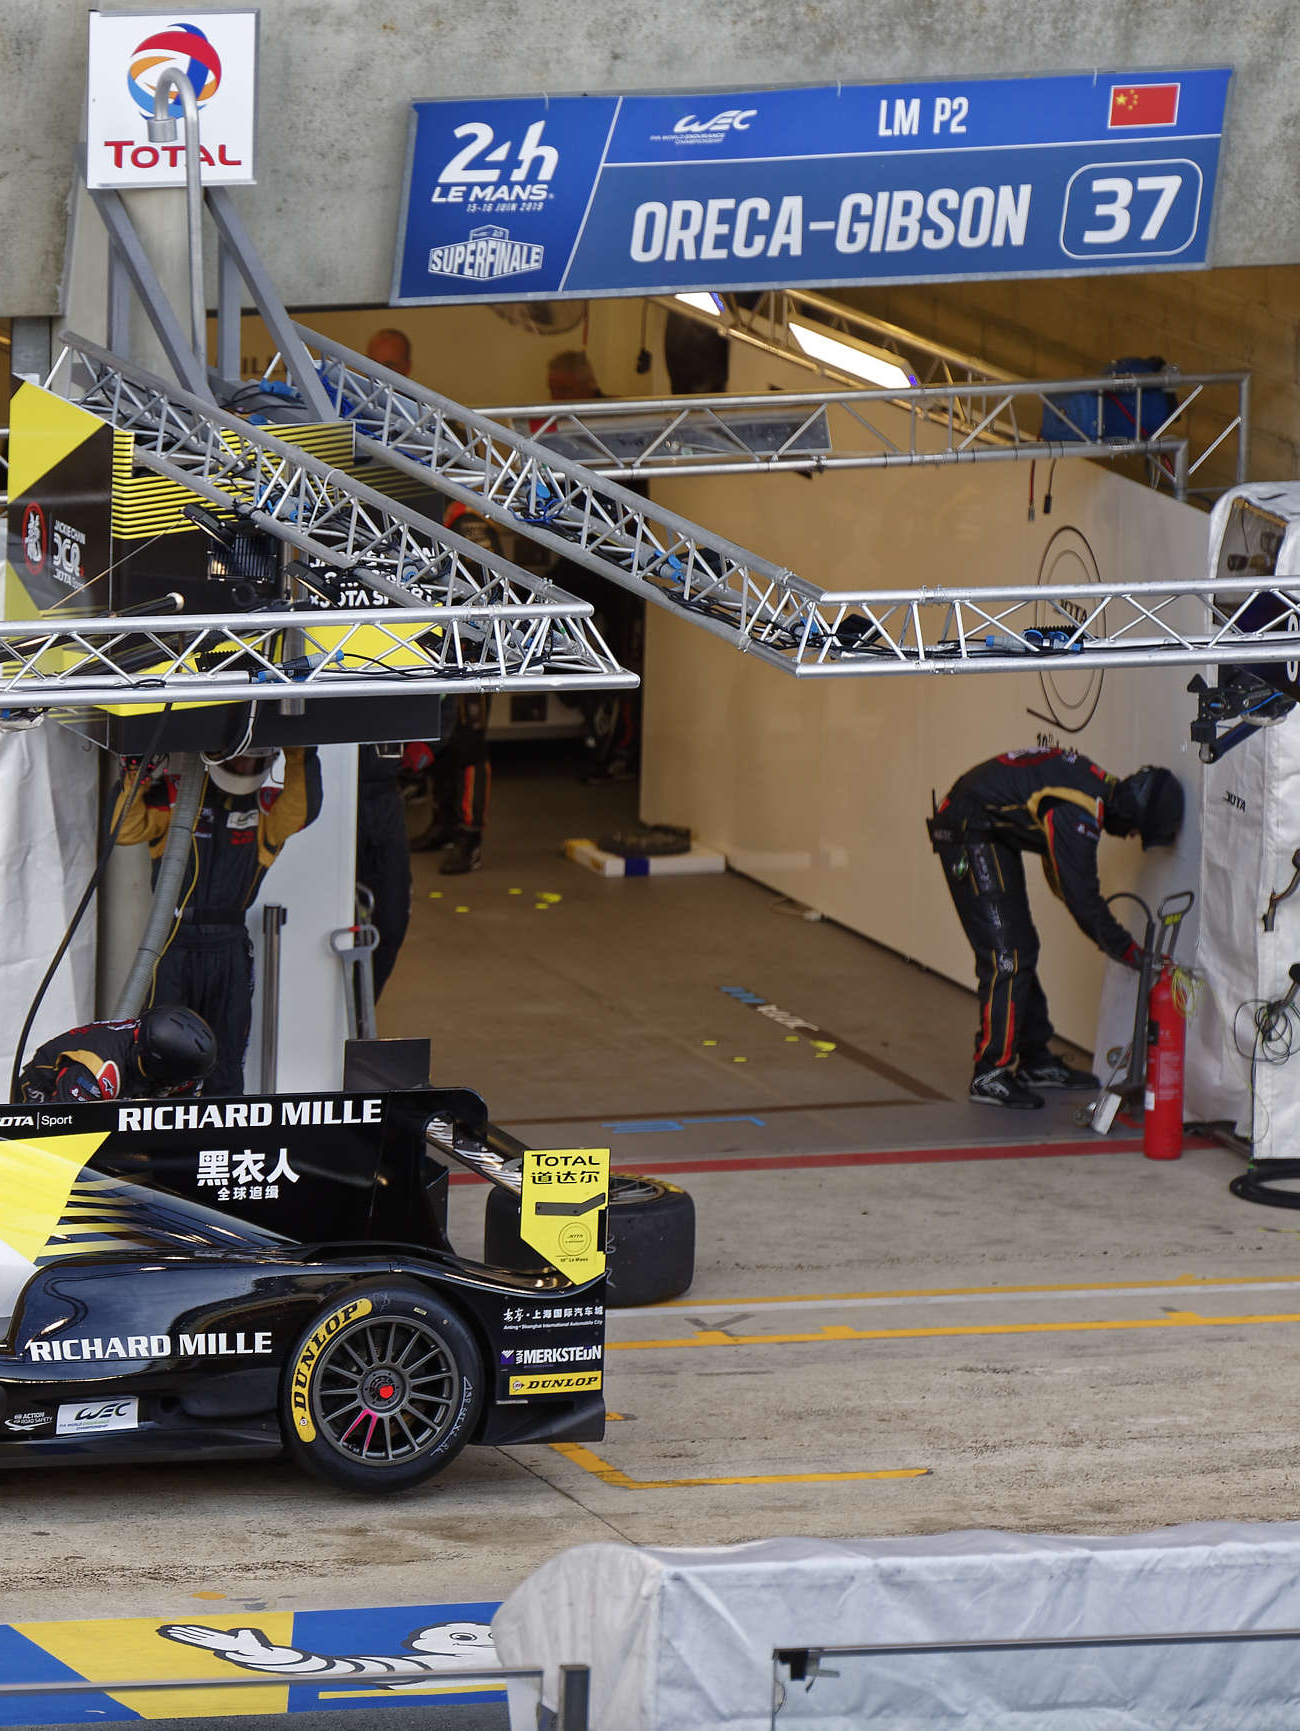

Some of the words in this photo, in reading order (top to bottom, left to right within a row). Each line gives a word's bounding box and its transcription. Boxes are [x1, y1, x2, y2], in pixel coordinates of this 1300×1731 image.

[673, 109, 758, 133] WEC
[878, 98, 921, 136] LM
[933, 96, 969, 134] P2
[437, 120, 559, 183] 24h
[431, 186, 467, 203] LE
[1083, 175, 1183, 243] 37
[630, 182, 1032, 263] ORECA-GIBSON
[431, 239, 542, 279] SUPERFINALE
[41, 1115, 73, 1127] Sport
[118, 1104, 272, 1132] RICHARD
[281, 1099, 382, 1126] MILLE
[197, 1148, 300, 1186] 黑衣人
[531, 1154, 600, 1167] TOTAL
[531, 1171, 600, 1184] 道达尔
[29, 1334, 171, 1362] RICHARD
[179, 1331, 273, 1356] MILLE
[294, 1302, 359, 1412] DUNLOP
[527, 1377, 598, 1389] DUNLOP
[23, 1411, 45, 1419] ACTION
[75, 1402, 131, 1420] WEC
